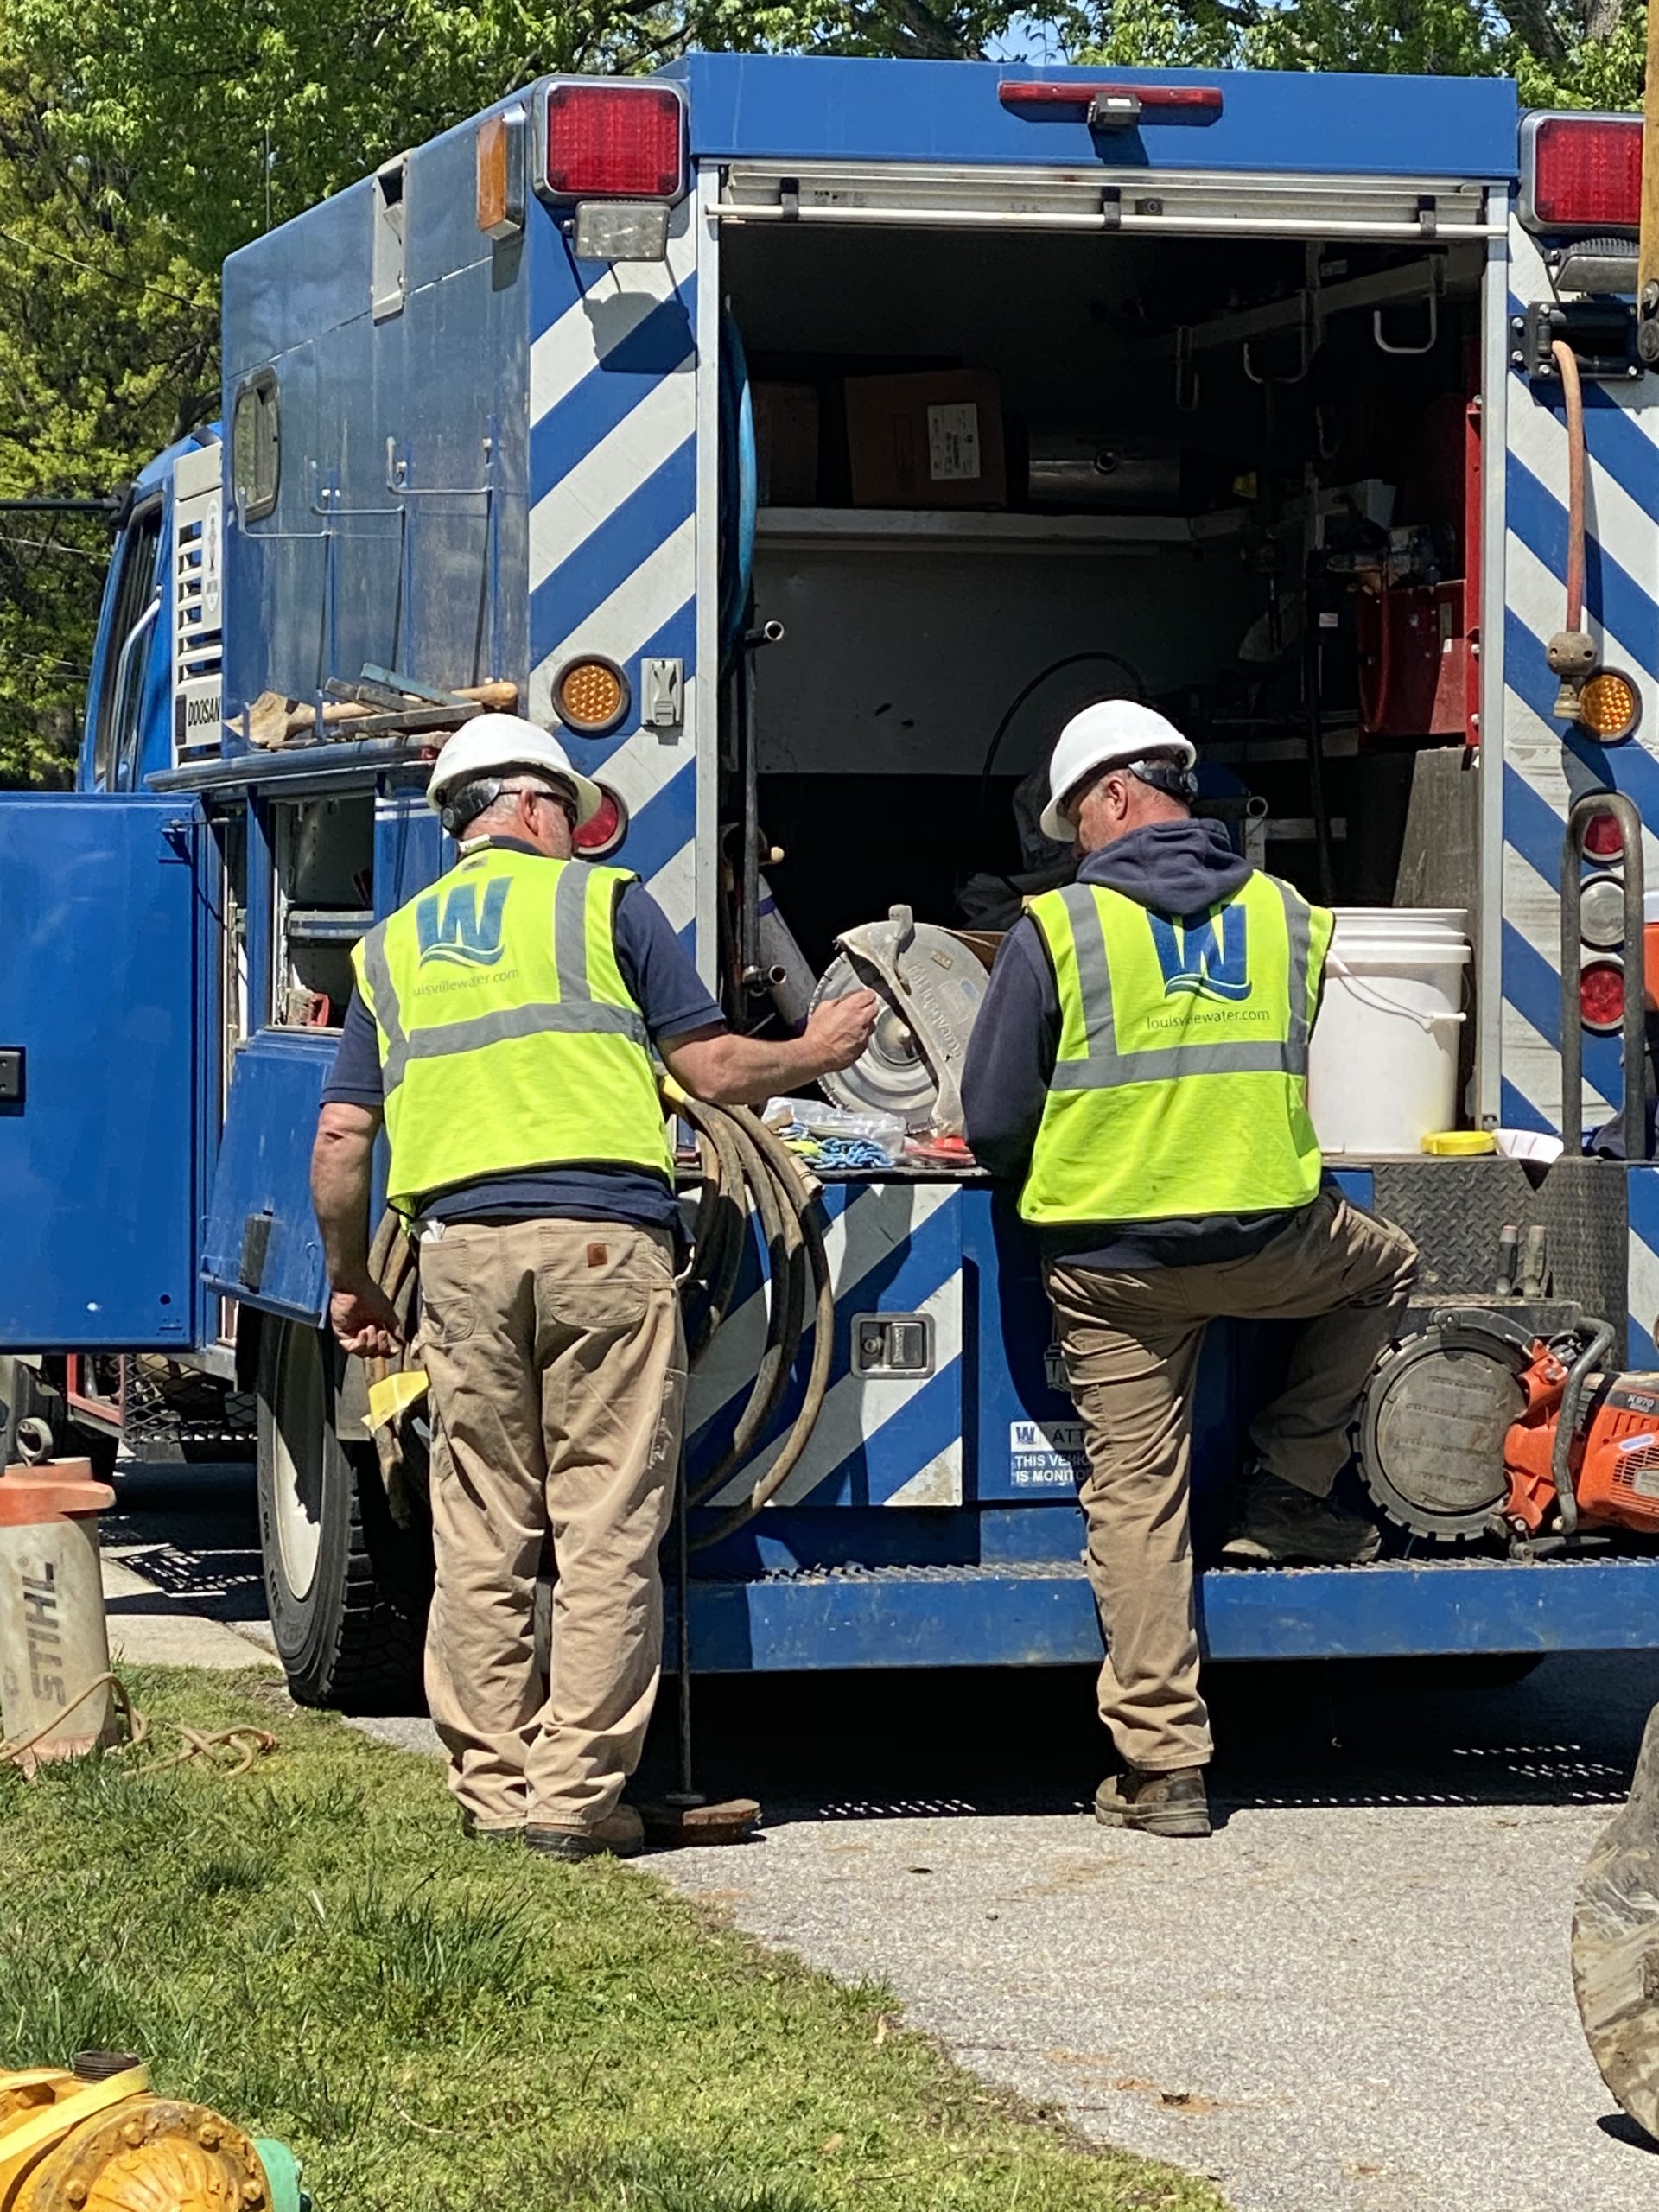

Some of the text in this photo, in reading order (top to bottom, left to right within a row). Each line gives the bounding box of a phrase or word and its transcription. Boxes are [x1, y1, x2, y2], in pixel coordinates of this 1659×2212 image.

[188, 696, 221, 727] DOOSAN
[1052, 1428, 1084, 1443] ATT
[1014, 1453, 1090, 1468] THIS VEHIC
[1015, 1469, 1087, 1483] IS MONITO
[22, 1562, 66, 1707] STIHL
